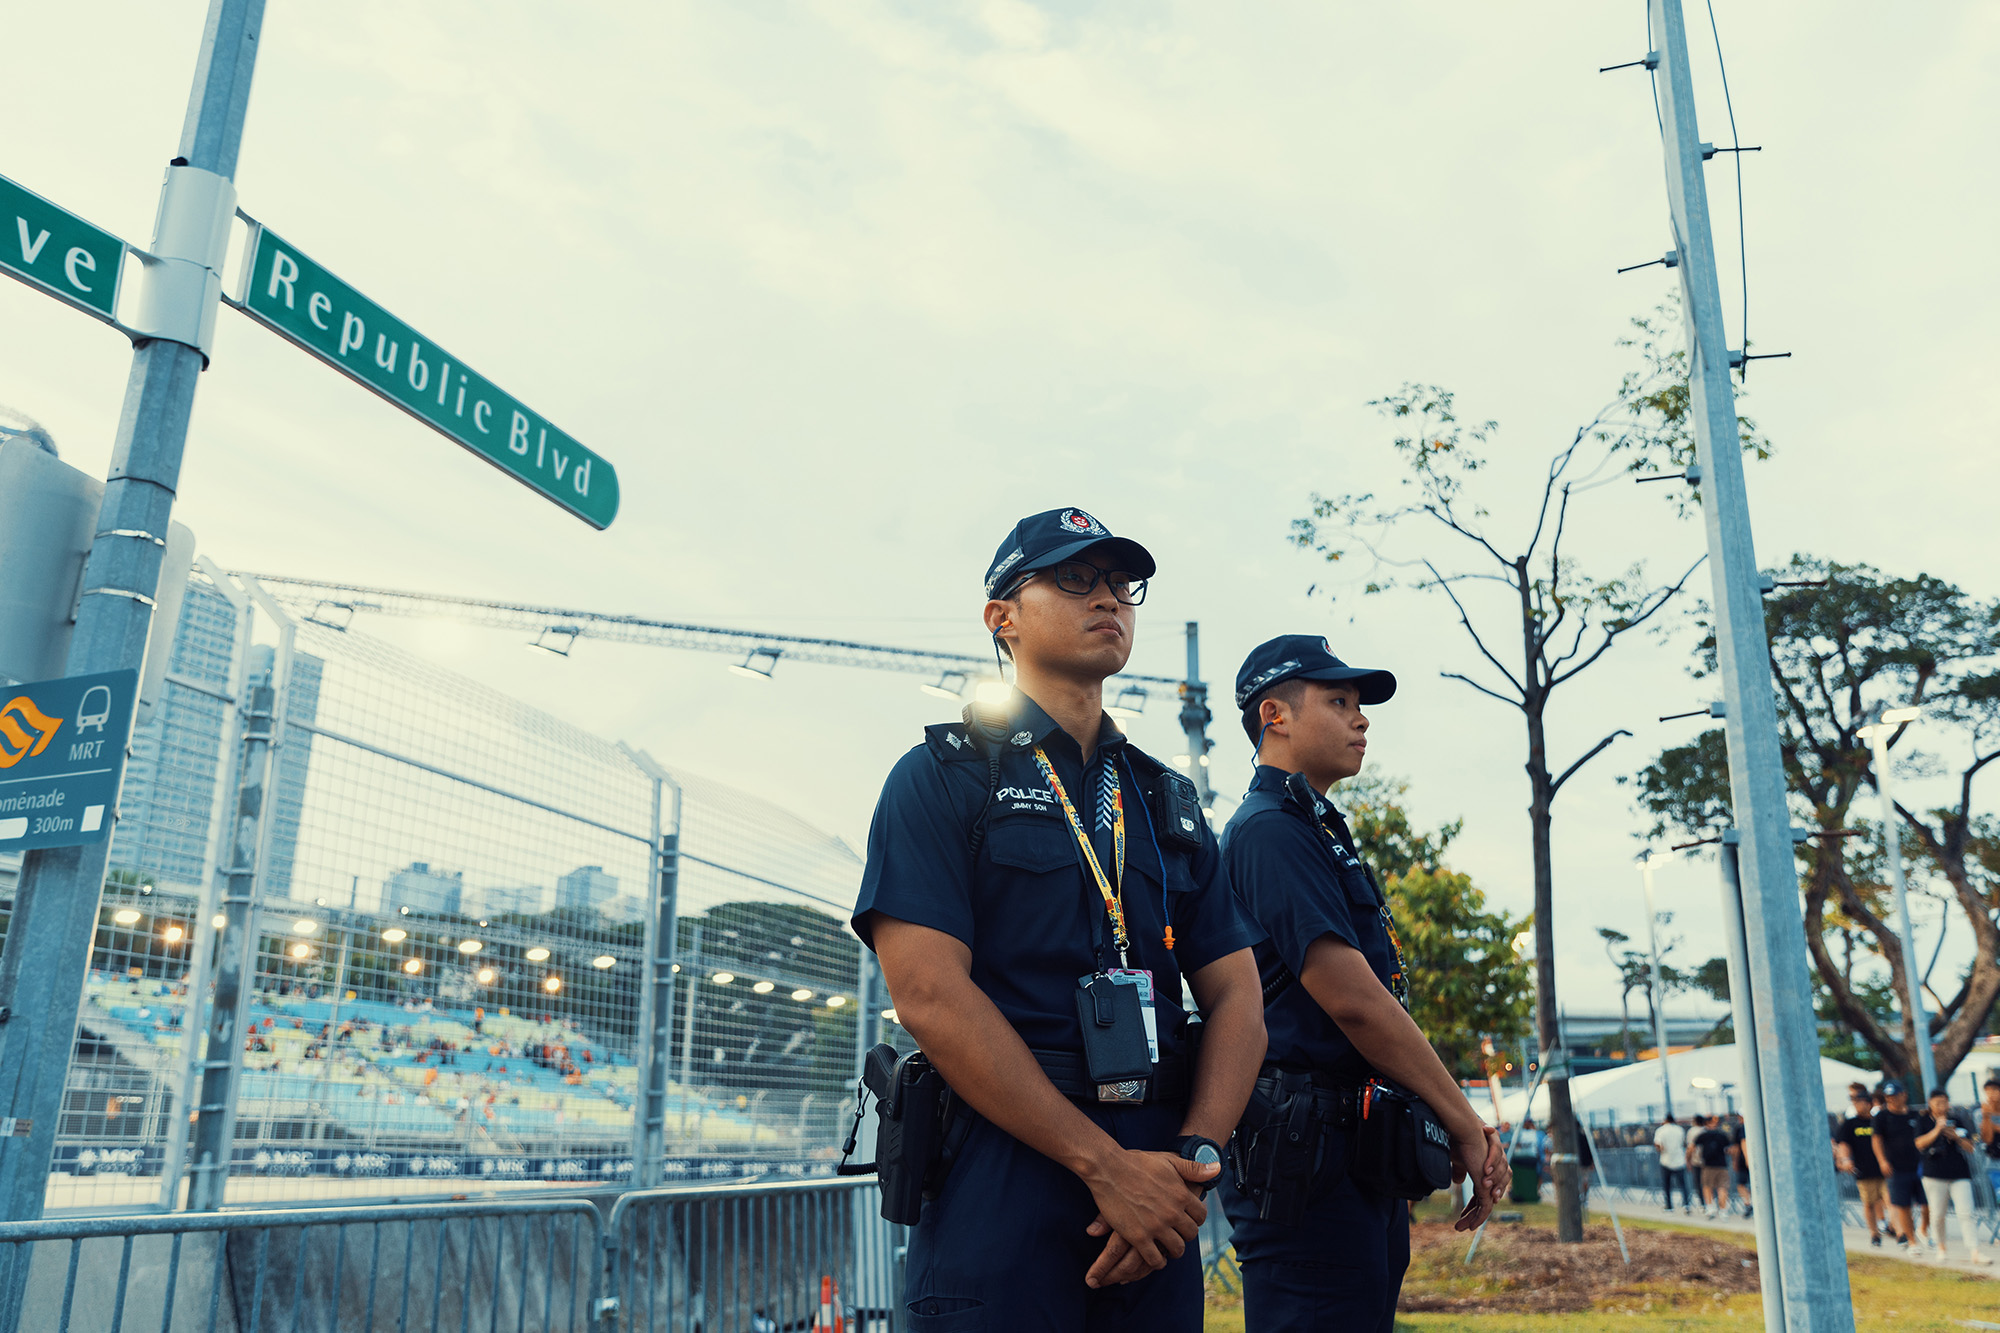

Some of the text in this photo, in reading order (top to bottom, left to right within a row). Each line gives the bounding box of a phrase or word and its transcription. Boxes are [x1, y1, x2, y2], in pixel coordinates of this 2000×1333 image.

[15, 216, 98, 293] ve
[266, 249, 592, 498] Republic Blvd
[68, 740, 105, 761] MRT
[0, 788, 65, 812] menade
[996, 786, 1054, 803] POLICE
[1011, 802, 1032, 810] JIMMY
[33, 816, 74, 834] 300m
